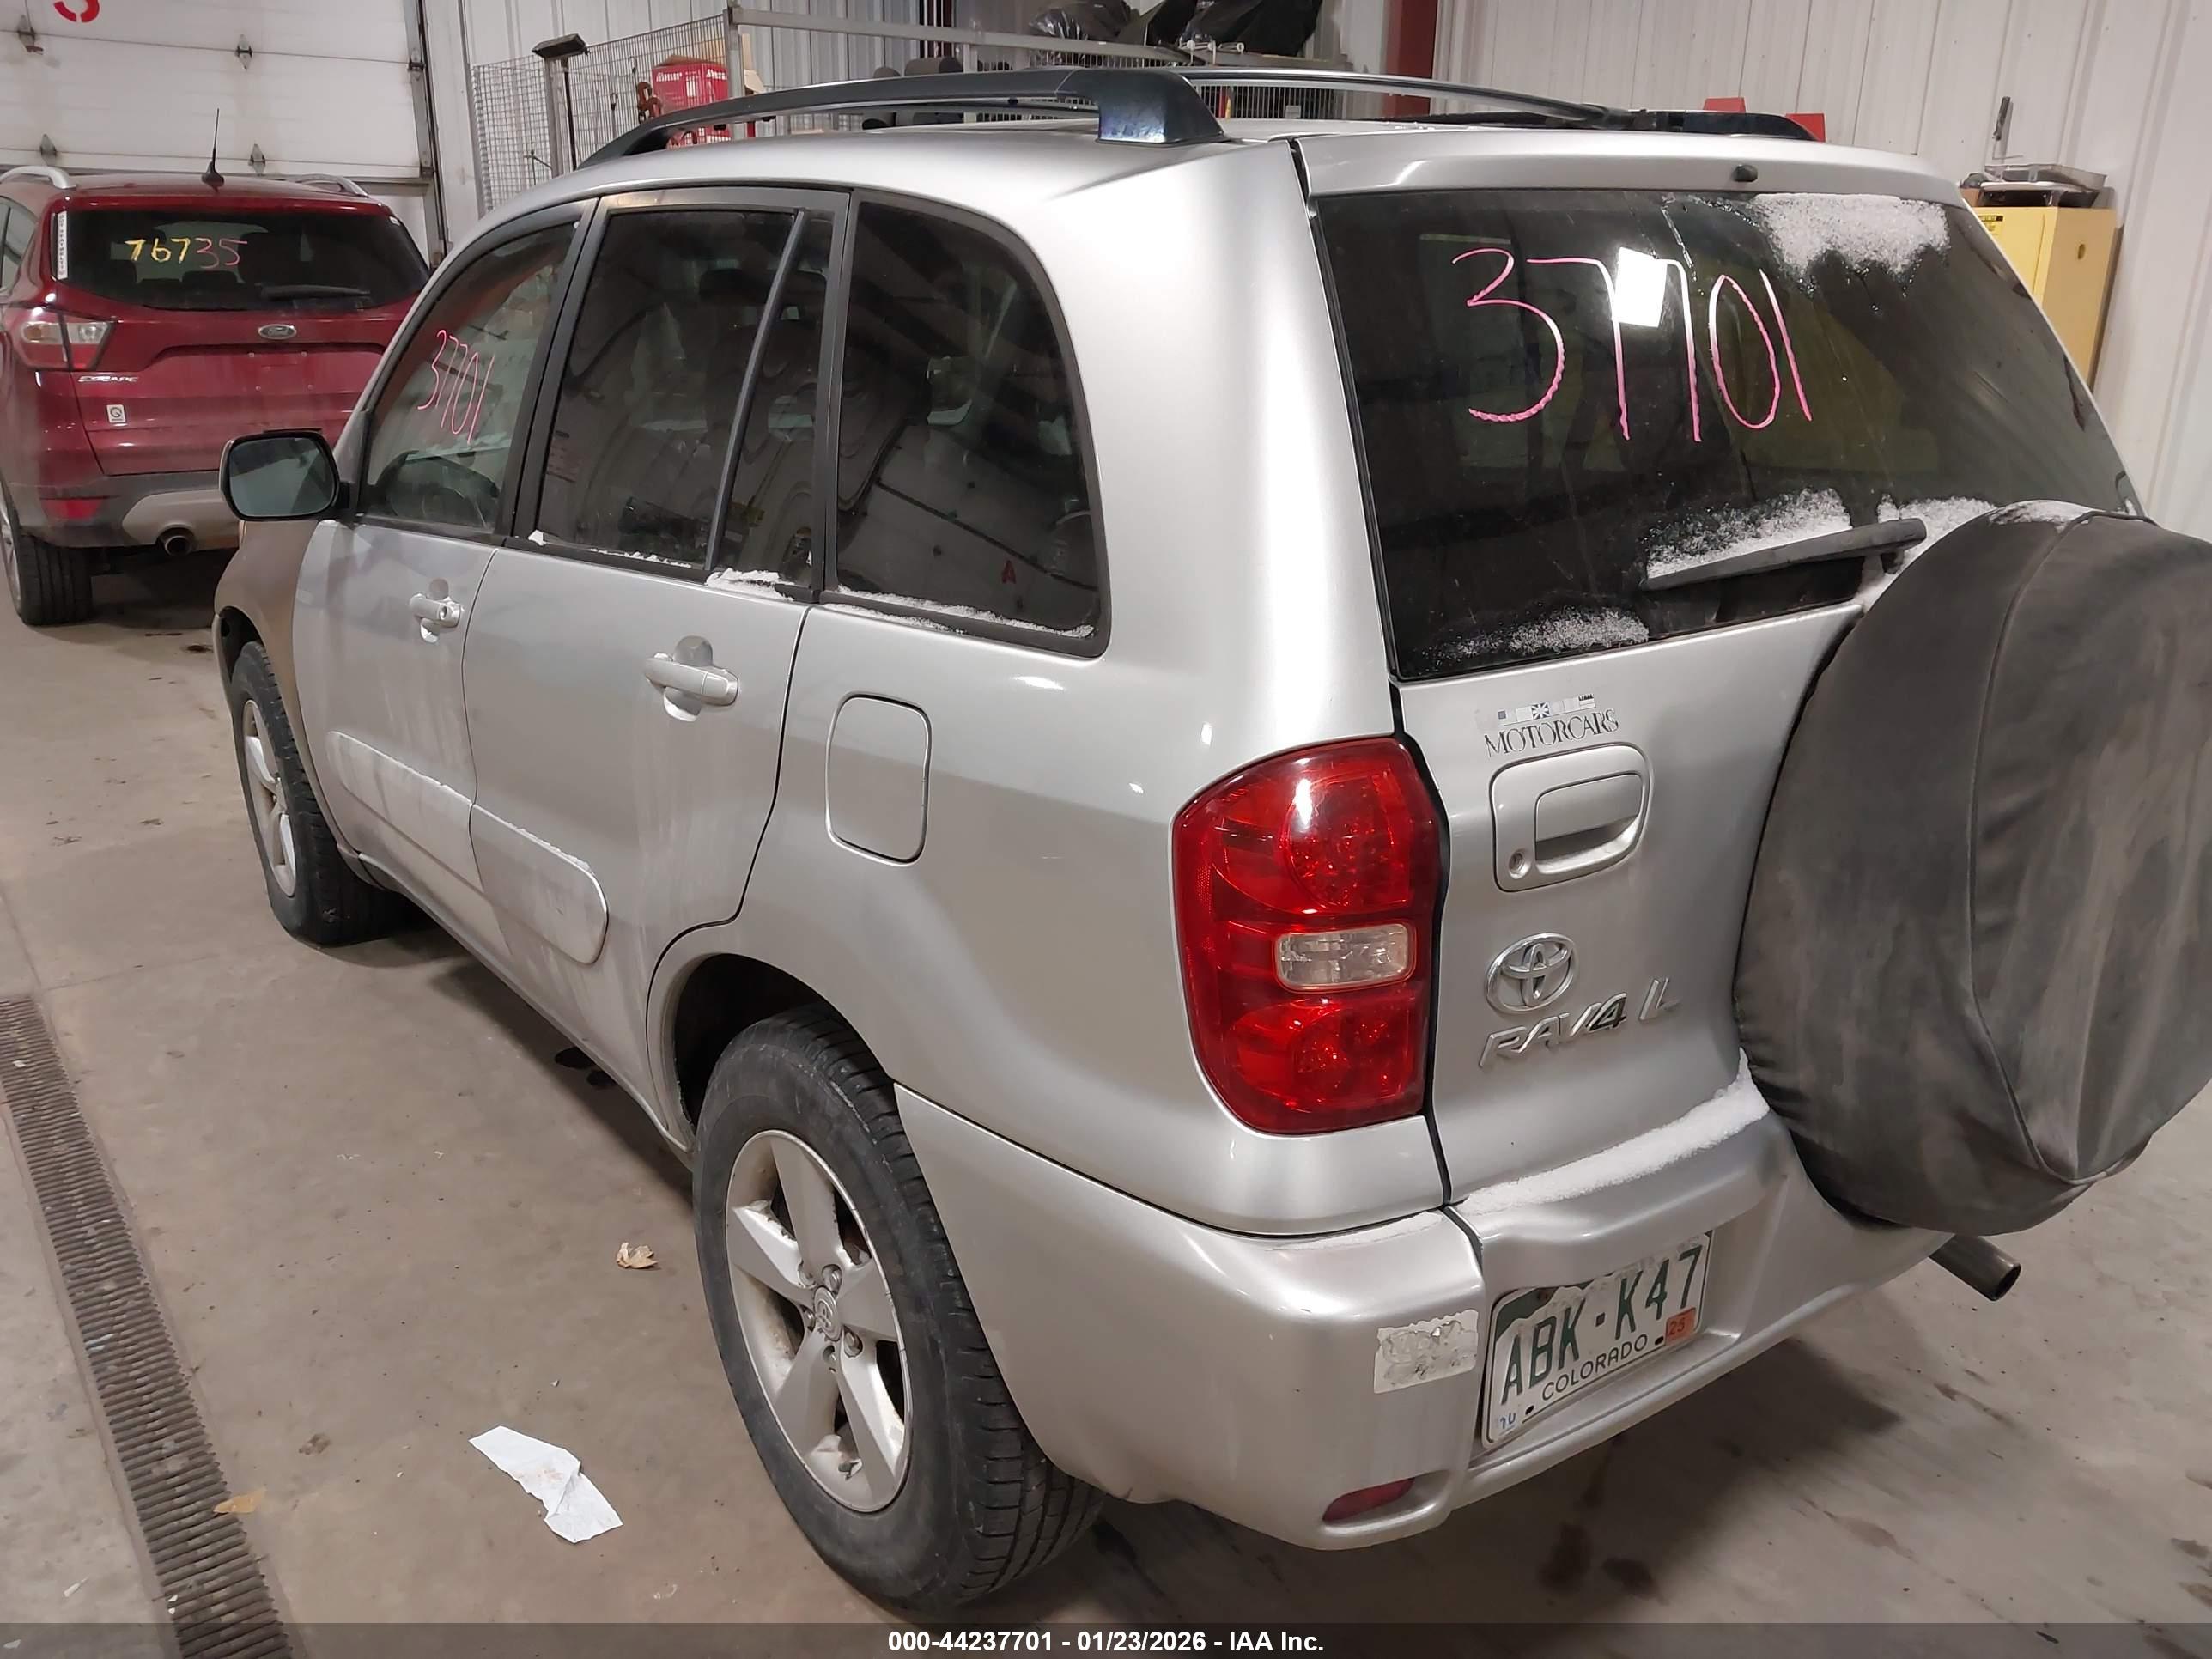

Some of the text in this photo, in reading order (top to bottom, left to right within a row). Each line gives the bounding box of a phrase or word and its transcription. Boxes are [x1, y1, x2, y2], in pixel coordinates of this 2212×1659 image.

[125, 237, 248, 269] 76735
[1451, 247, 1813, 442] 37701
[417, 329, 495, 445] 37701
[1484, 708, 1619, 757] MOTORCARS
[1479, 977, 1680, 1067] RAV4 L
[1542, 1334, 1648, 1401] COLORADO
